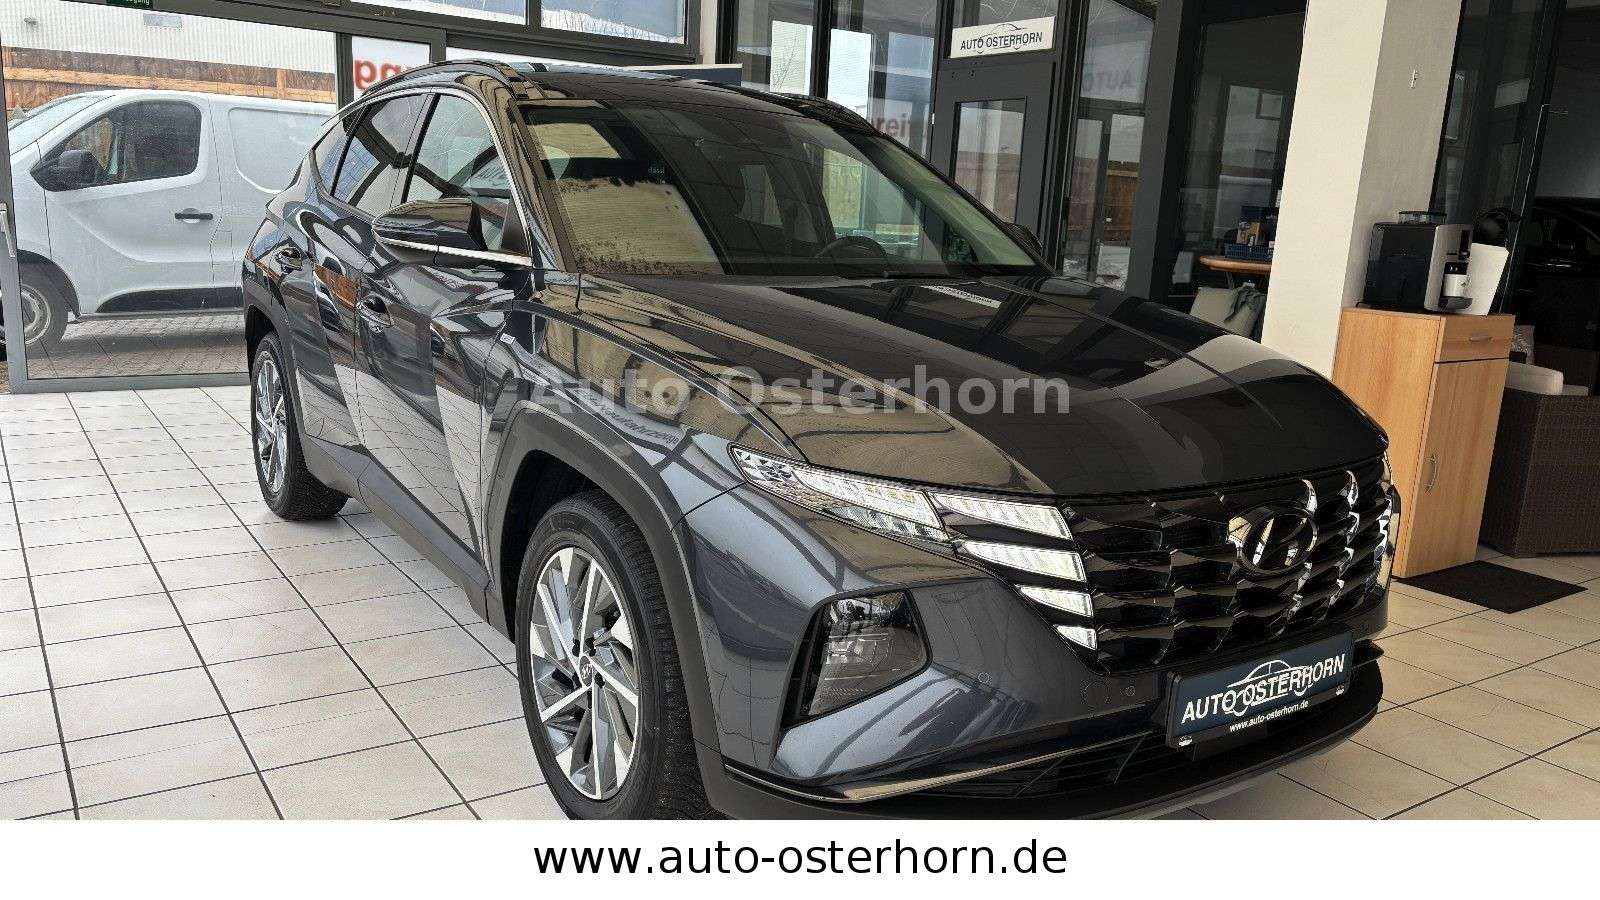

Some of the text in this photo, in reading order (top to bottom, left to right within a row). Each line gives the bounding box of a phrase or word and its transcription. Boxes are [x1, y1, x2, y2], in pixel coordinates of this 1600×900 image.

[960, 32, 1043, 50] AUTO OSTERHORN
[1181, 653, 1346, 724] AUTO OSTERHORN
[1229, 699, 1310, 733] www.auto-osterhorn.de
